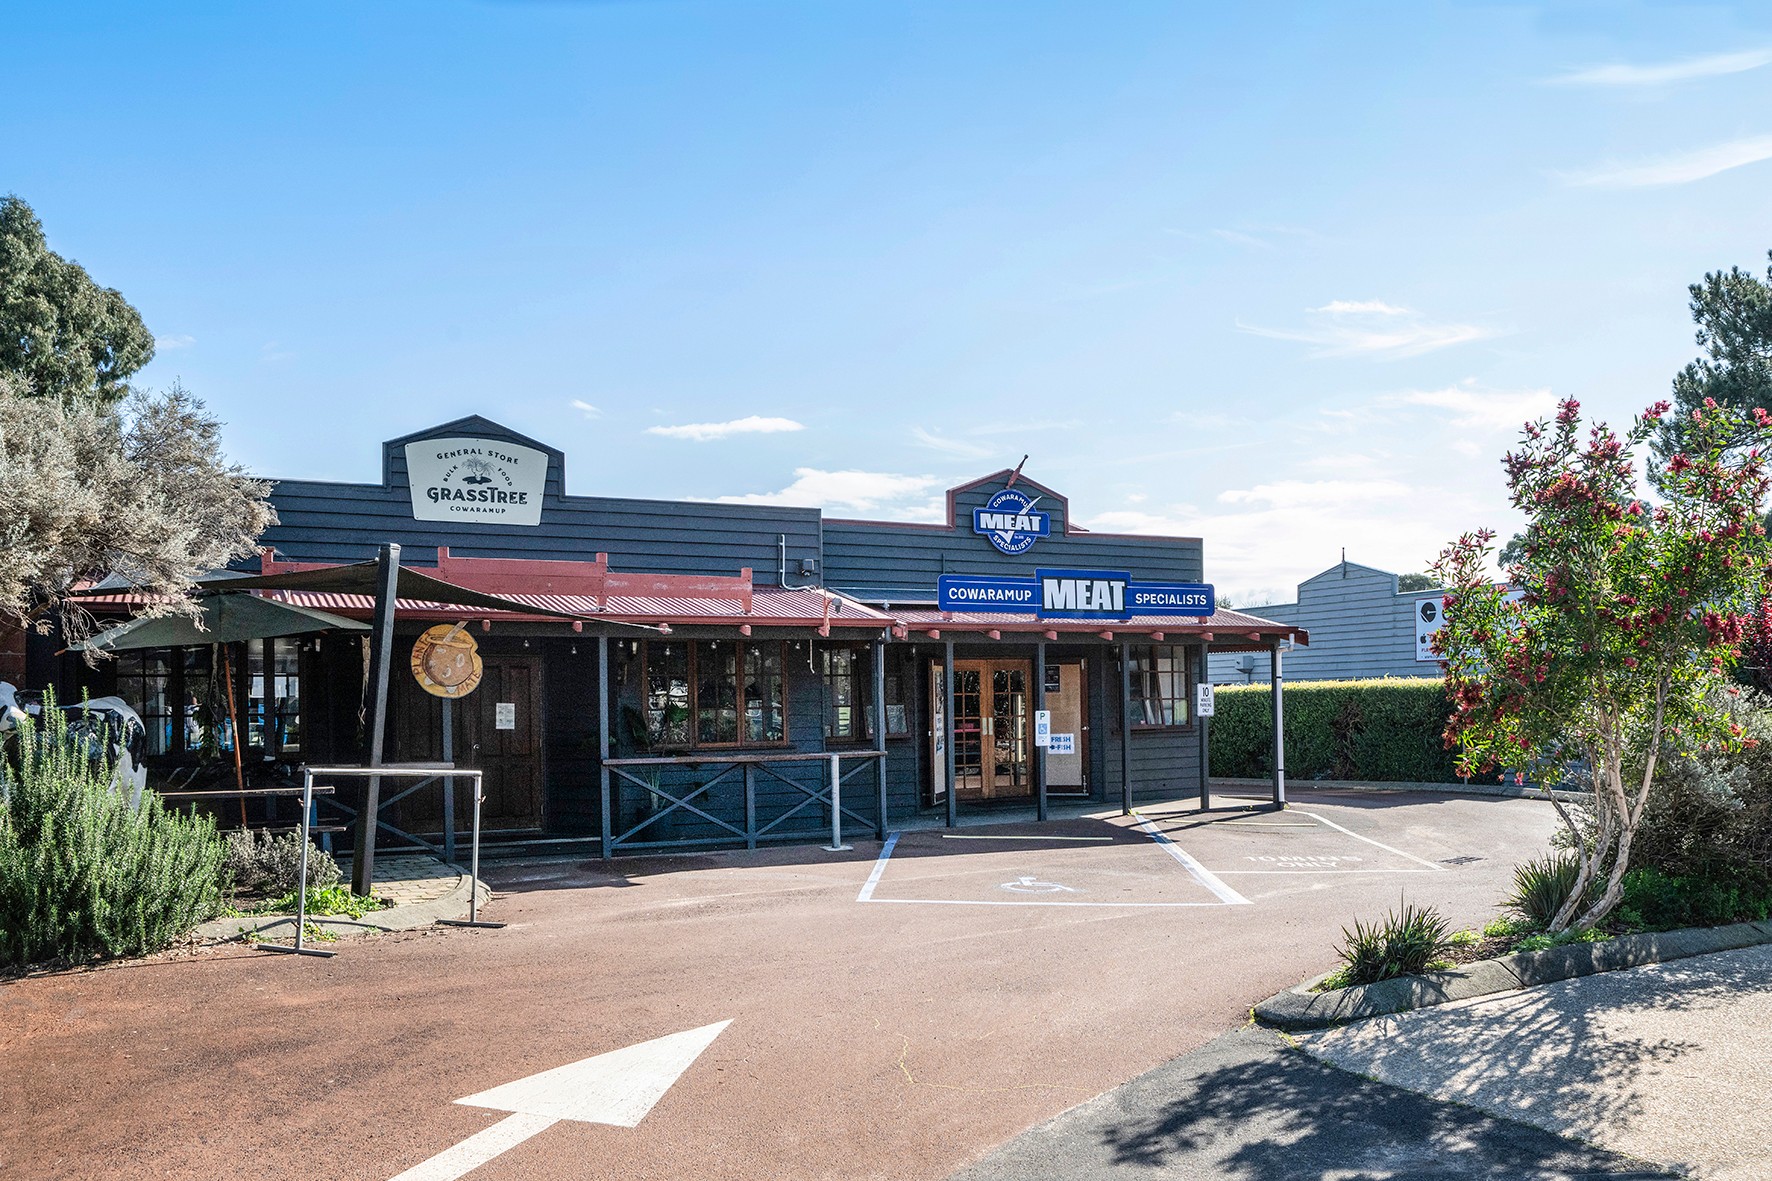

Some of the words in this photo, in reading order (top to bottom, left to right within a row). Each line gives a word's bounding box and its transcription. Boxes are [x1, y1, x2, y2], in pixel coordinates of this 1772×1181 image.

[437, 449, 482, 459] GENERAL
[488, 451, 519, 464] STORE
[443, 465, 458, 482] BULK
[498, 467, 513, 487] FOOD
[427, 487, 528, 505] GRASSTREE
[450, 505, 506, 514] COWARAMUP
[980, 513, 1041, 531] MEAT
[993, 535, 1032, 551] SPECIALISTS
[948, 587, 1032, 601] COWARAMUP
[1042, 579, 1126, 611] MEAT
[1135, 593, 1207, 605] SPECIALISTS
[457, 671, 481, 695] MATE
[1203, 687, 1210, 697] 10
[1040, 712, 1046, 720] P
